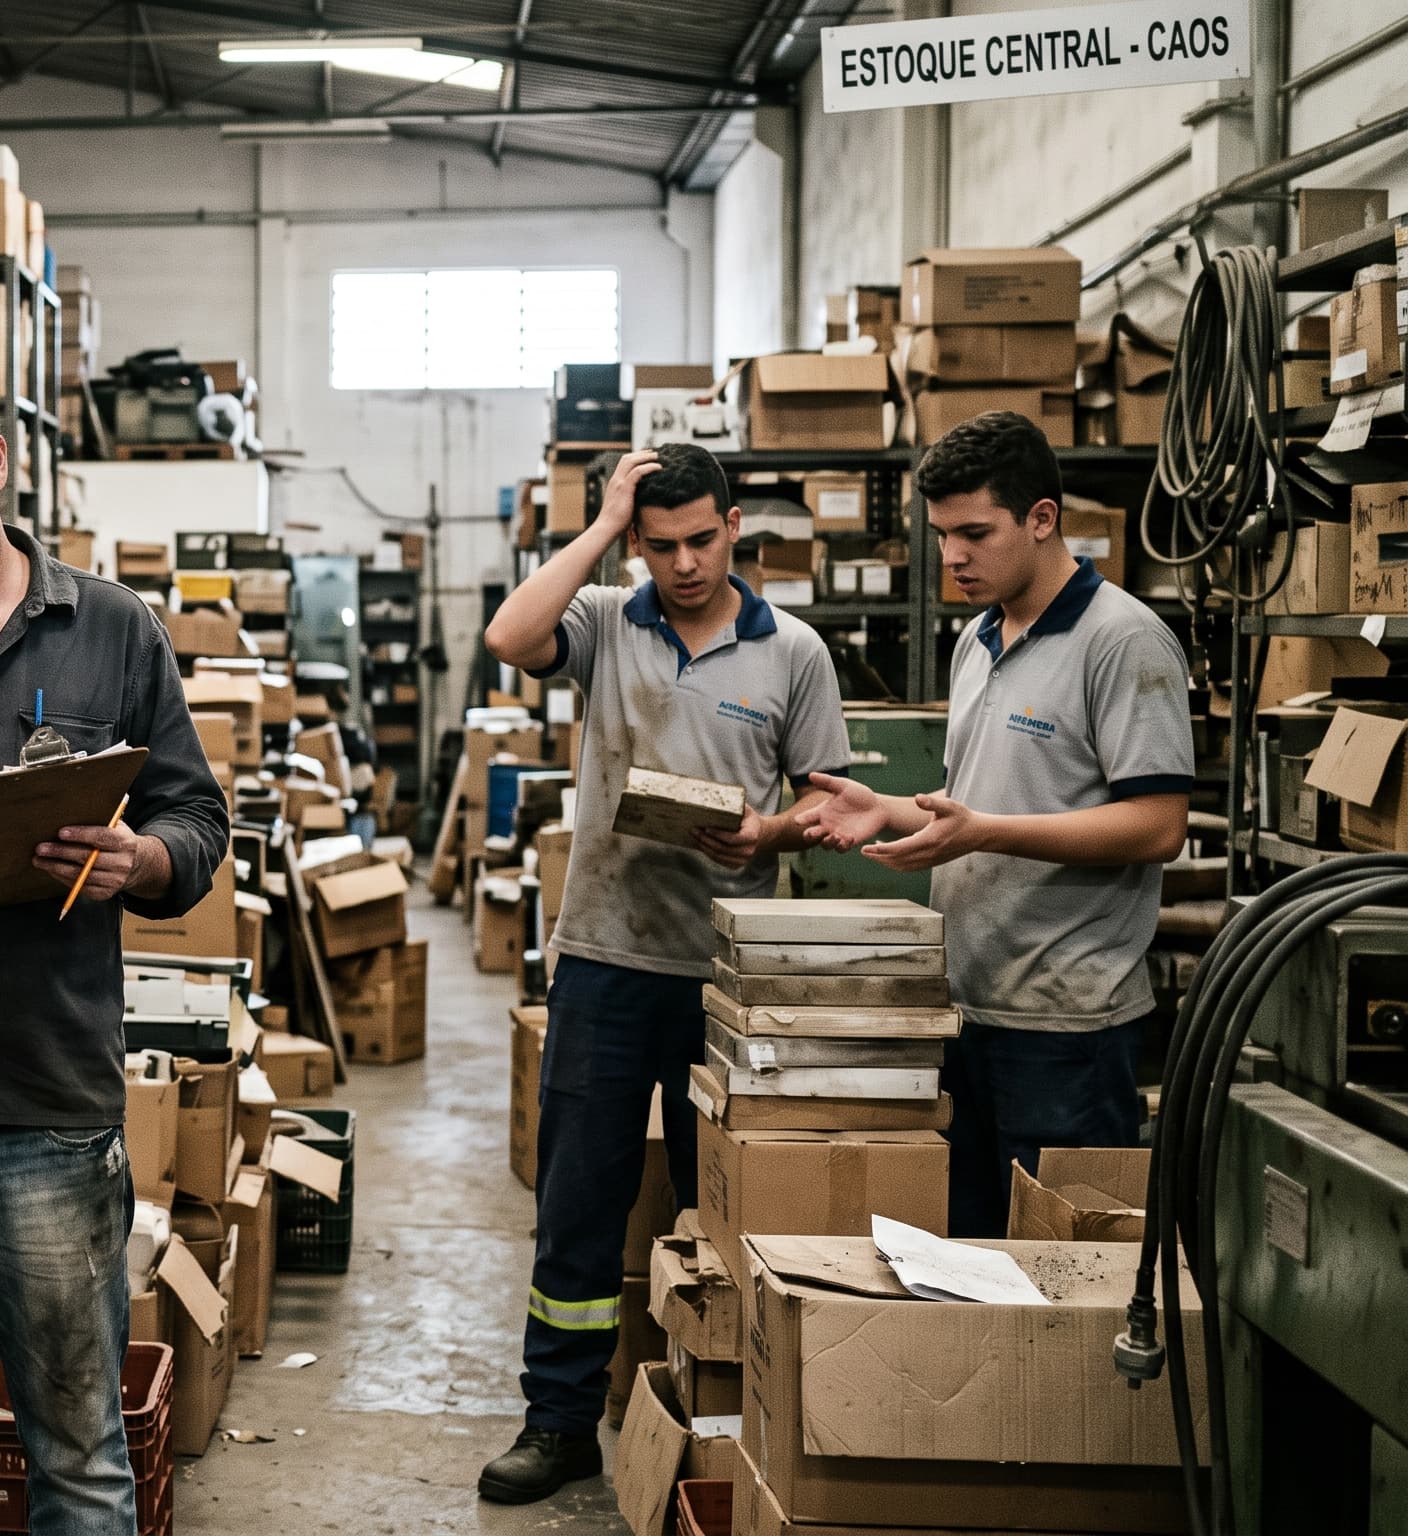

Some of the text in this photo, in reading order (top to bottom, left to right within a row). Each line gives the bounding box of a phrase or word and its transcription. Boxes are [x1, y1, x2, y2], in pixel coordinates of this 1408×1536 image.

[841, 15, 1230, 88] ESTOQUE CENTRAL - CAOS
